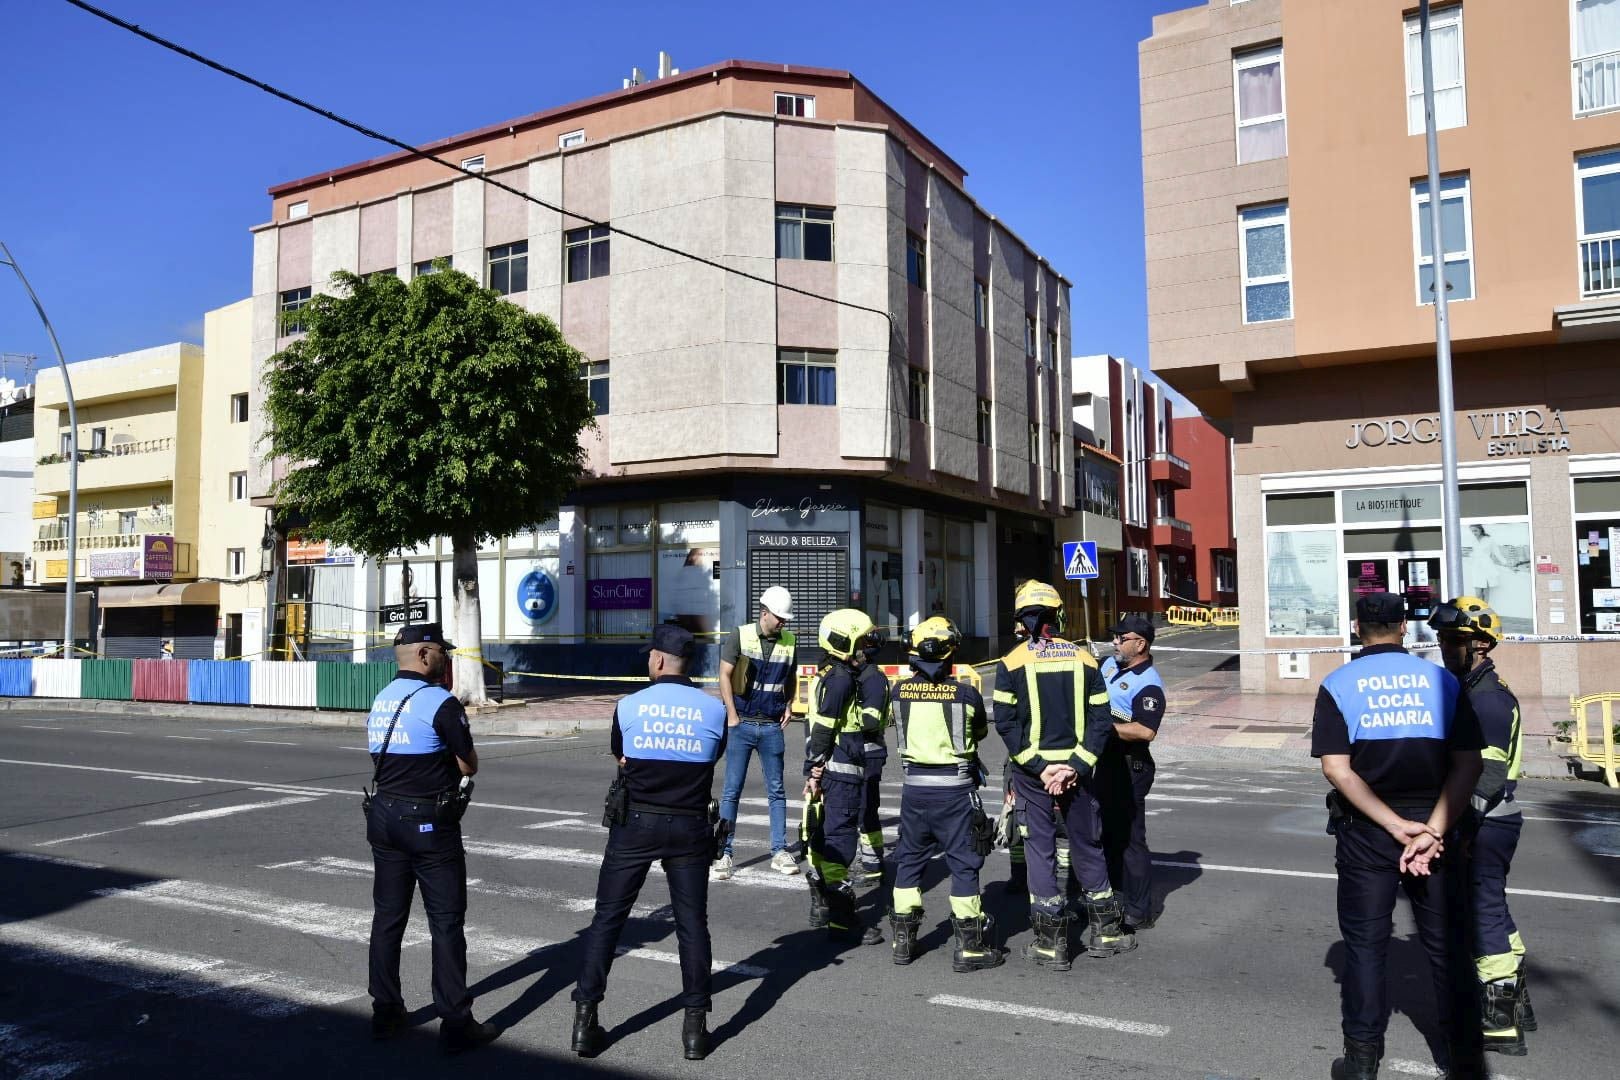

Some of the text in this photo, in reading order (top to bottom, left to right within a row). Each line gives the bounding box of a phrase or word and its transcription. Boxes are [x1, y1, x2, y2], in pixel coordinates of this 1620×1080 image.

[1345, 408, 1571, 451] JORG VIERA
[1487, 437, 1571, 457] ESTILISTA
[1356, 498, 1423, 511] LA BIOSTHETIQUE
[759, 535, 838, 546] SALUD & BELLEZA
[592, 584, 646, 600] SkinClinic
[1052, 650, 1076, 658] CANARIA
[900, 682, 958, 692] BOMBEROS
[1357, 674, 1430, 693] POLICIA
[899, 691, 956, 700] GRAN CANARIA
[1367, 692, 1425, 710] LOCAL
[638, 703, 704, 722] POLICIA
[1360, 710, 1434, 729] CANARIA
[643, 720, 696, 736] LOCAL
[633, 735, 703, 753] CANARIA
